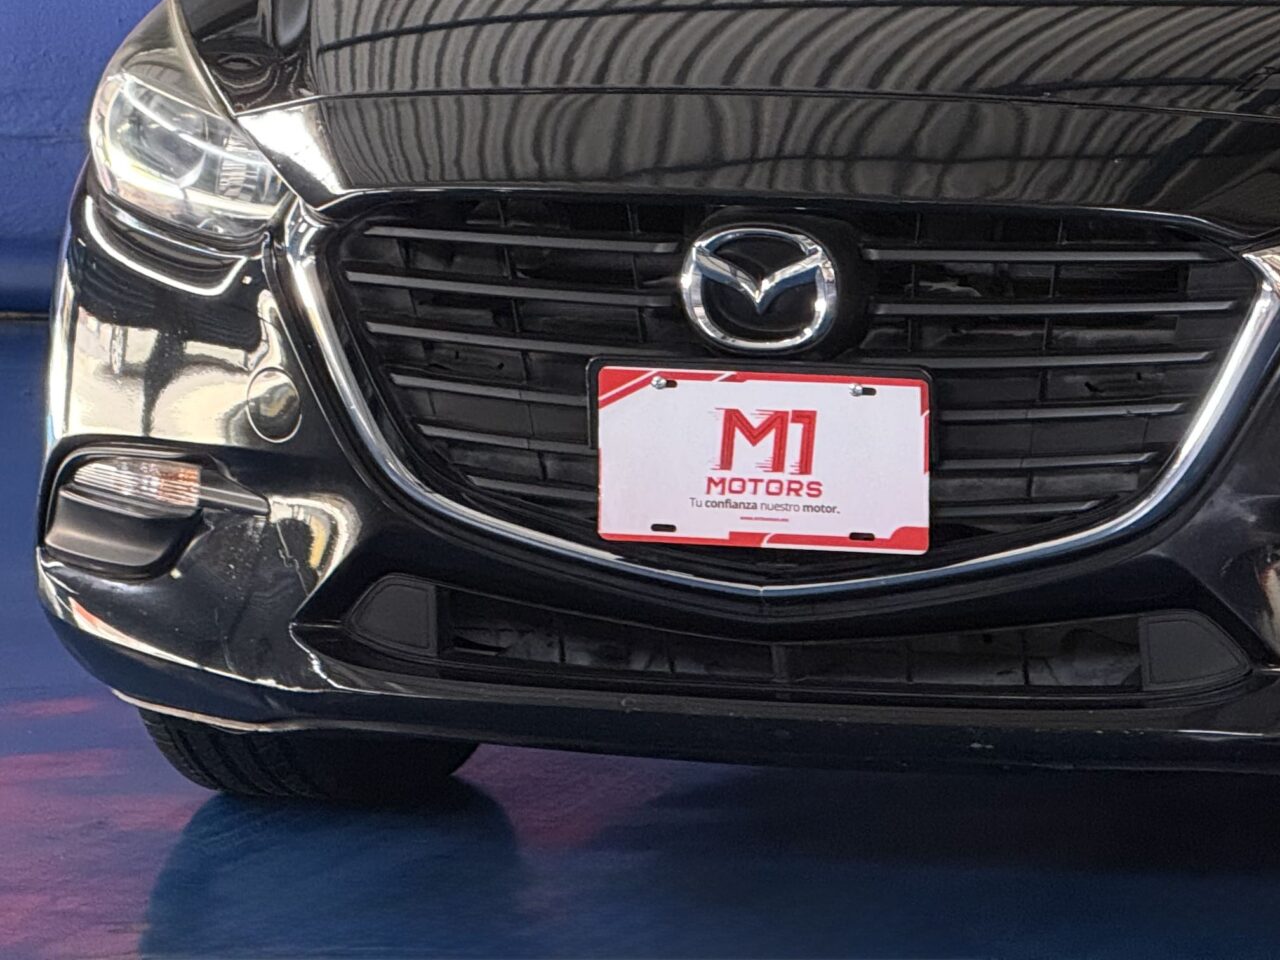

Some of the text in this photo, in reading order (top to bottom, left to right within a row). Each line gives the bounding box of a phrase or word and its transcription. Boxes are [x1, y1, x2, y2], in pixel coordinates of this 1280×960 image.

[708, 407, 817, 475] M1
[705, 477, 823, 498] MOTORS
[689, 497, 841, 514] Tu confianza nuestro motor.
